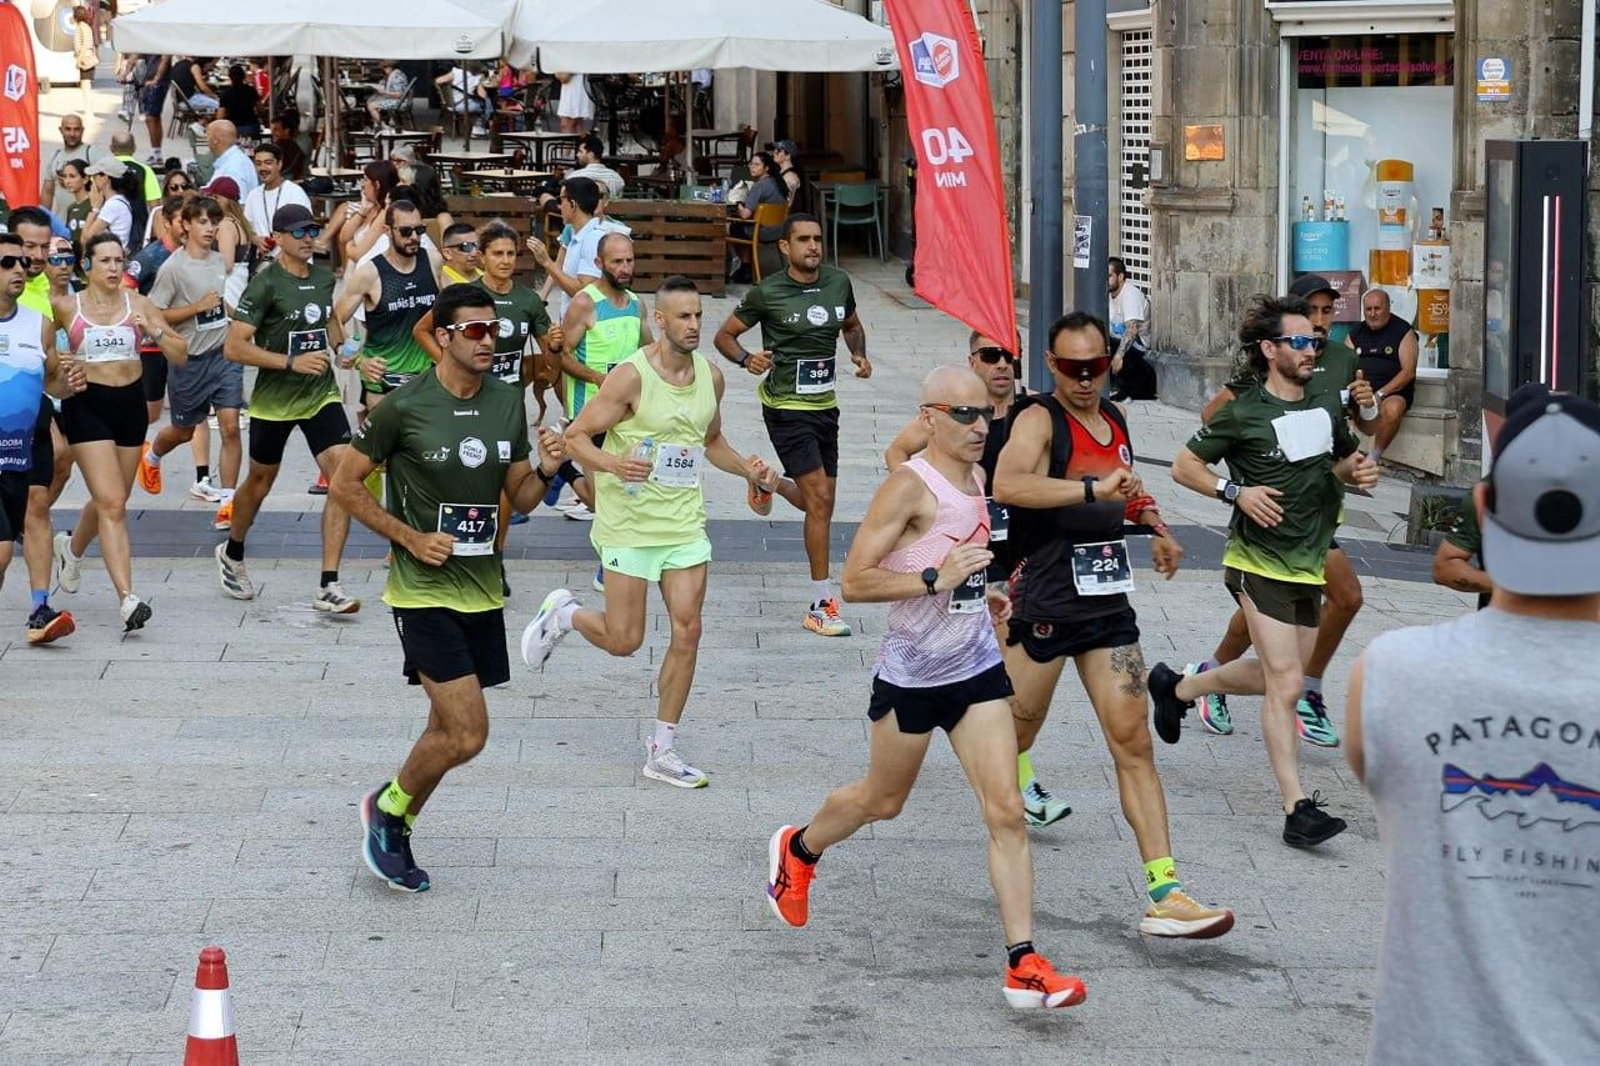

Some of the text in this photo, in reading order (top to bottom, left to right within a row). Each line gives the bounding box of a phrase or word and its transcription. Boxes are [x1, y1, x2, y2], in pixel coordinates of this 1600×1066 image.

[95, 337, 125, 347] 1341
[300, 340, 320, 349] 272
[492, 361, 511, 372] 270
[809, 368, 829, 378] 399
[666, 457, 694, 468] 1584
[457, 520, 486, 533] 417
[1092, 557, 1119, 572] 224
[1441, 844, 1600, 873] FLY FISHIN
